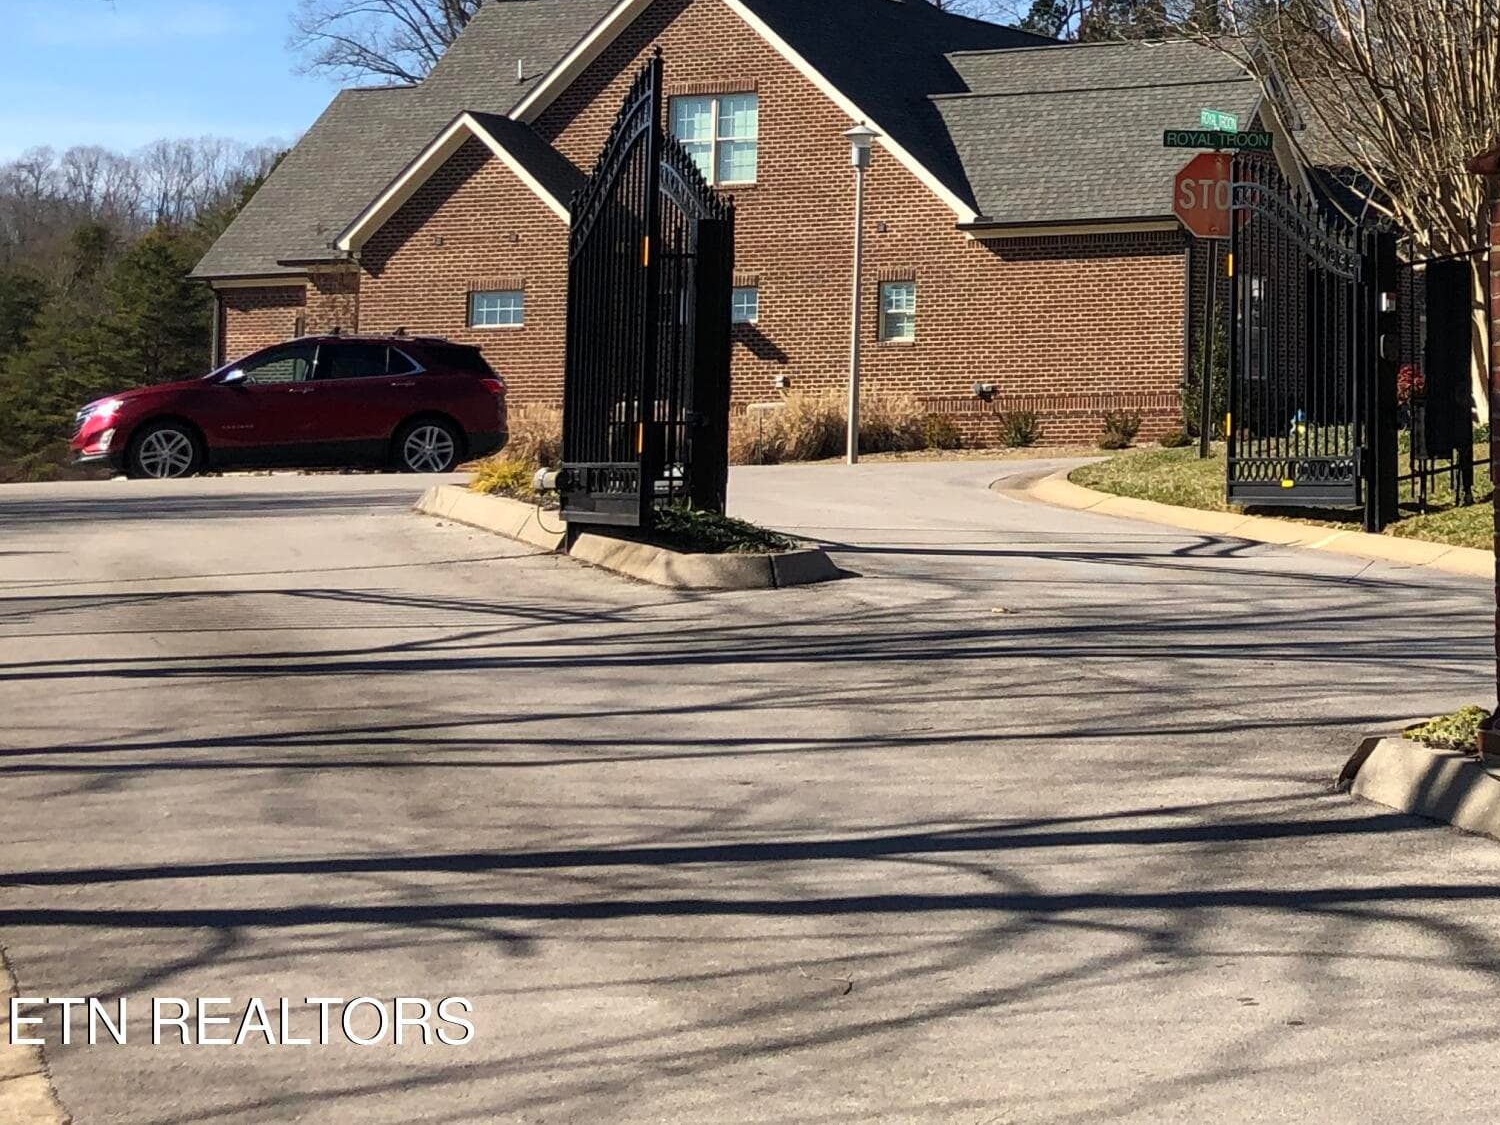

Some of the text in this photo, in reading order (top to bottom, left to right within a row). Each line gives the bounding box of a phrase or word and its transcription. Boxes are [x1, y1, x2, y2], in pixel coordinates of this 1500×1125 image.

[1167, 133, 1269, 146] ROYAL TROON
[1179, 178, 1236, 210] STO
